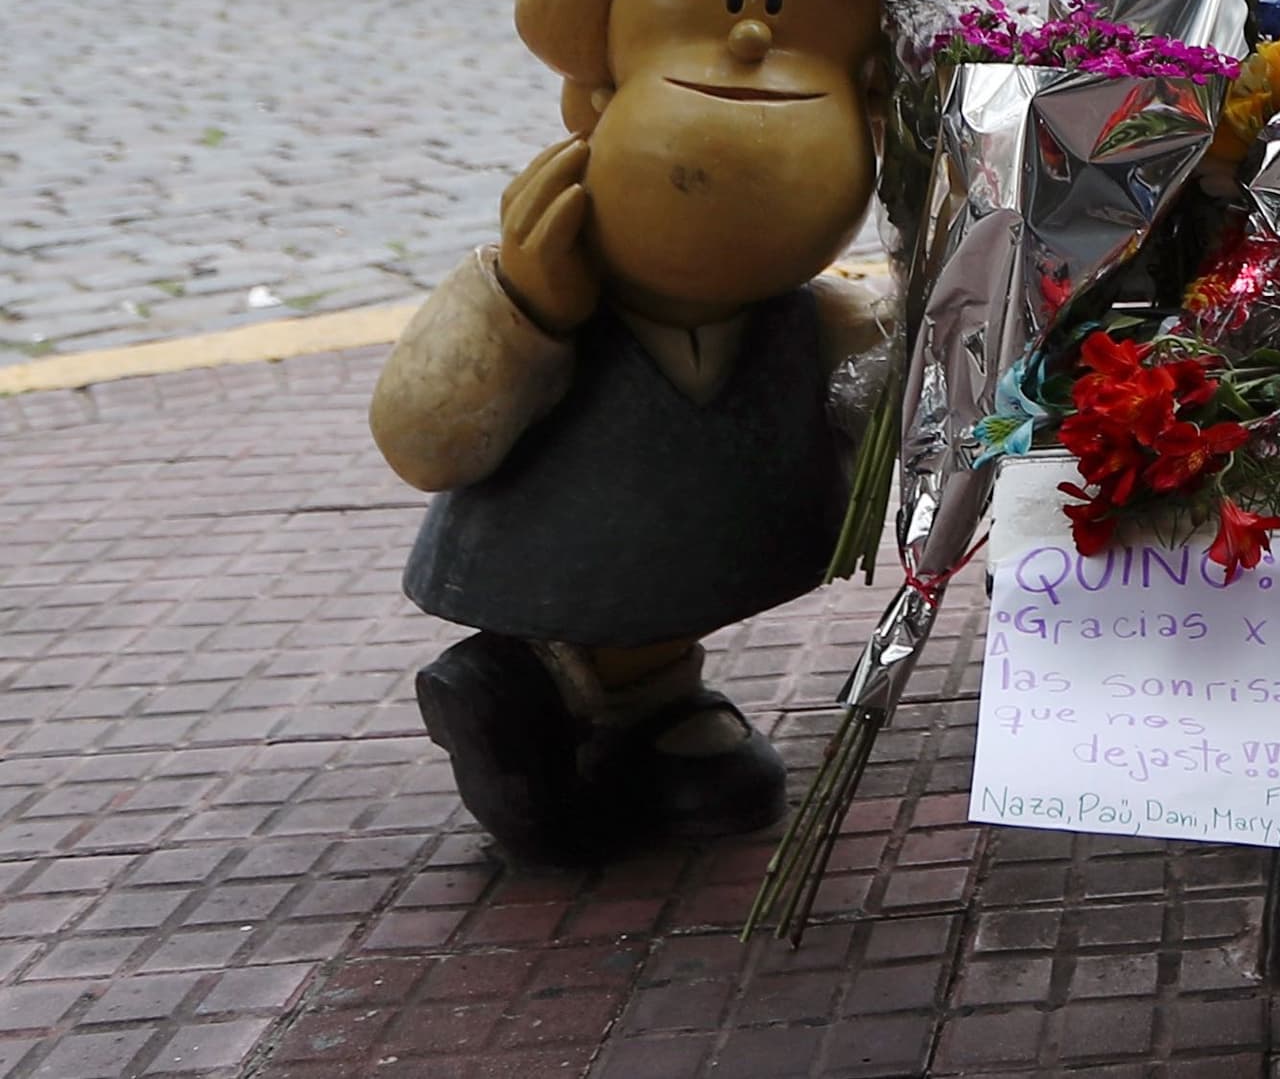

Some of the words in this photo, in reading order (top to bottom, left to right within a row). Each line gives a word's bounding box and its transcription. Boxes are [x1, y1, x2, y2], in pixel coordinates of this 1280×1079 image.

[1000, 658, 1072, 693] las
[993, 703, 1079, 736] que
[1106, 711, 1207, 736] nos
